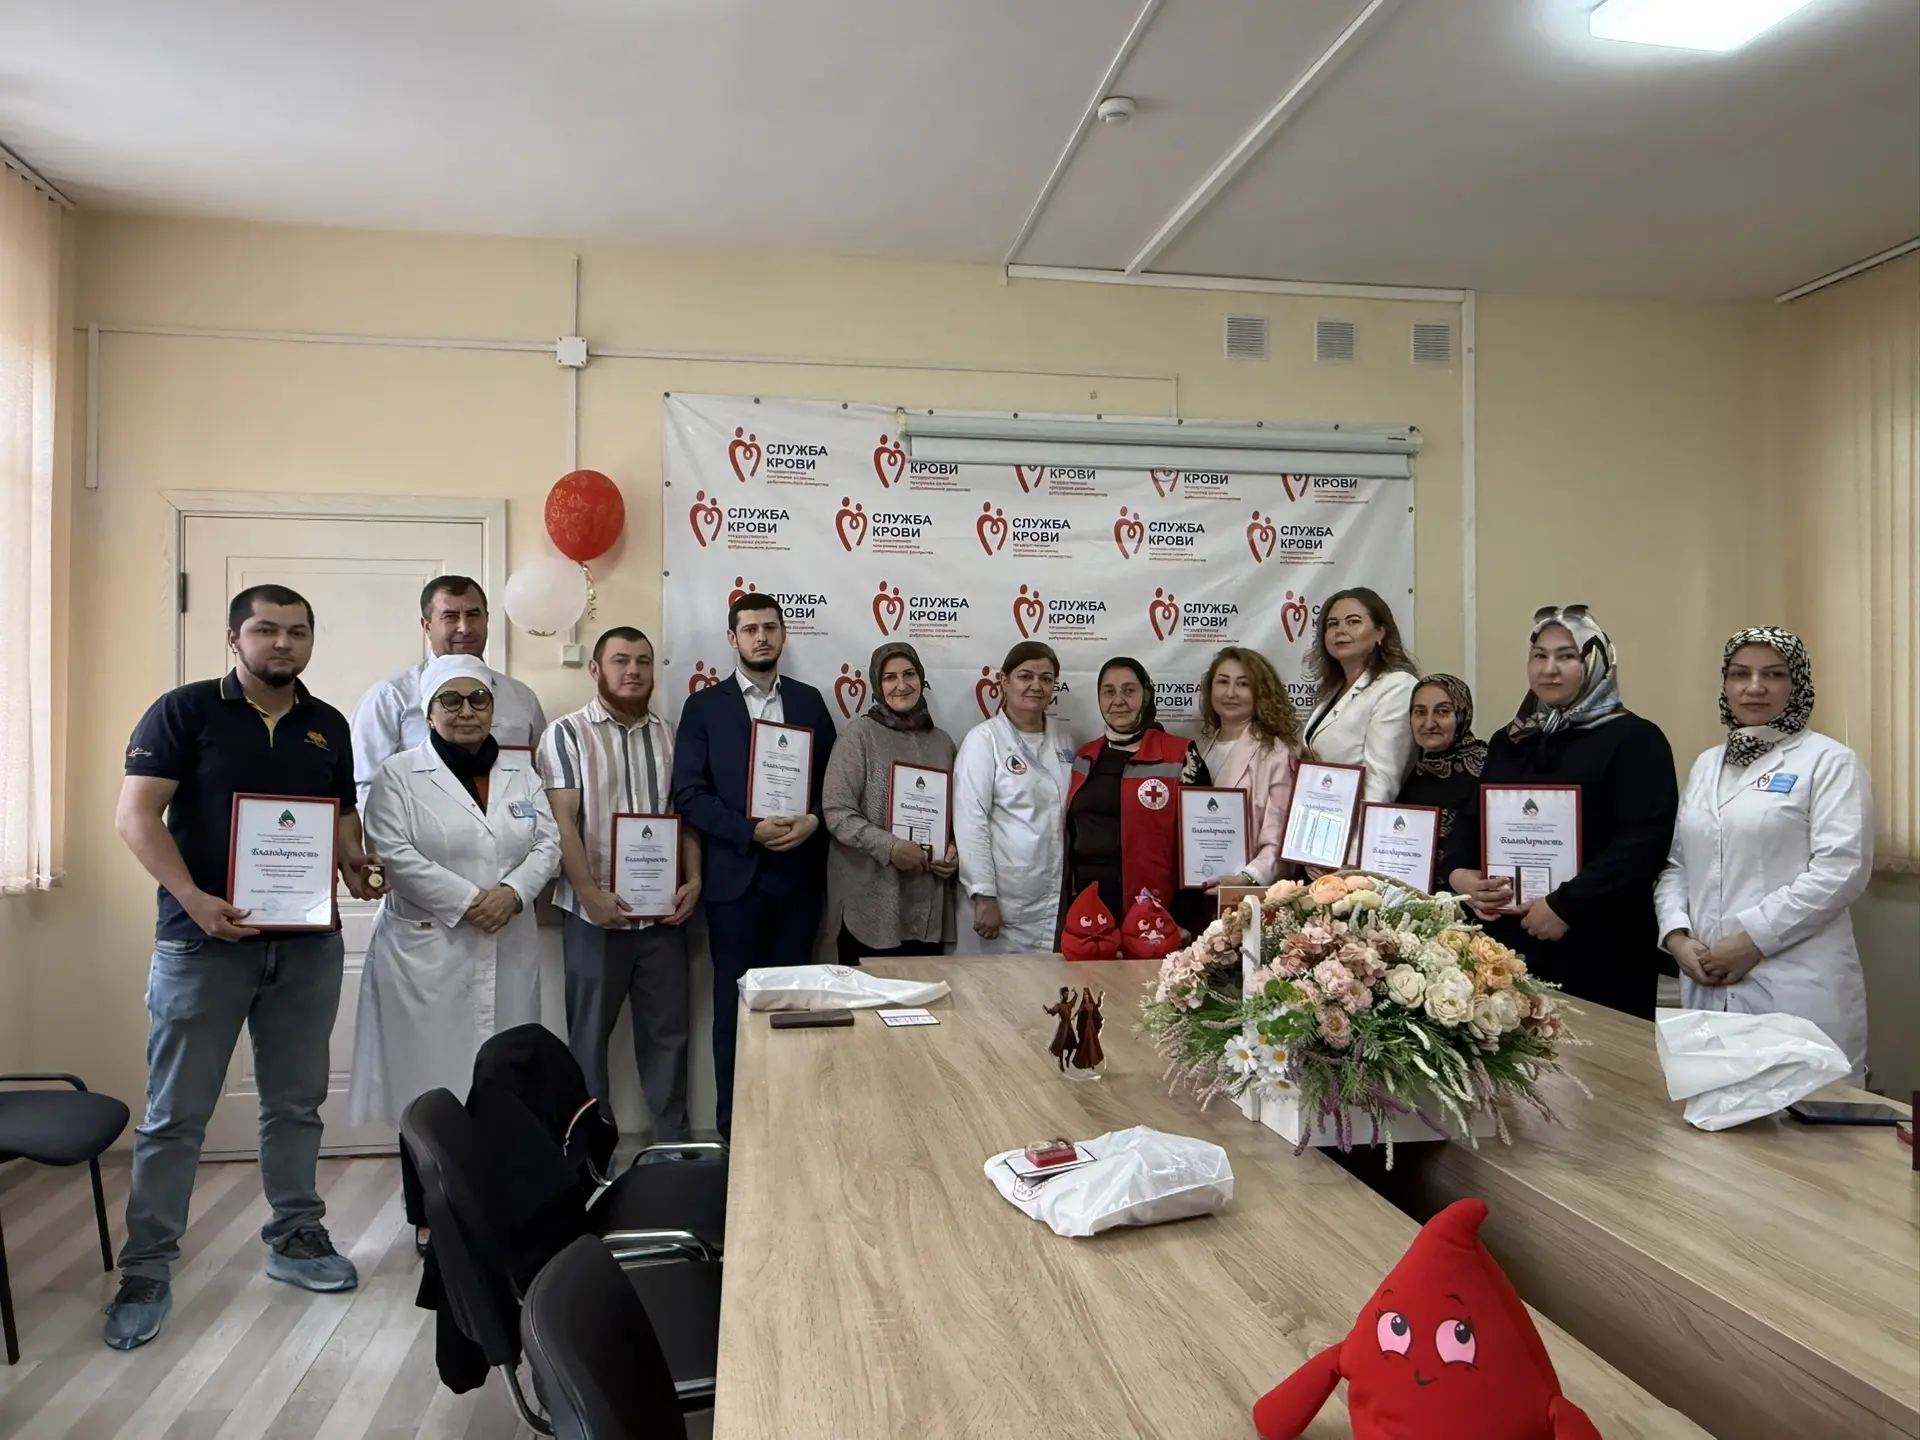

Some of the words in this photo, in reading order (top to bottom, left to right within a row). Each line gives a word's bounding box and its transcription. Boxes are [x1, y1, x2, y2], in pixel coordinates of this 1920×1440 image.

[766, 444, 828, 456] СЛУЖБА
[767, 458, 815, 470] КРОВИ
[910, 463, 958, 474] КРОВИ
[1050, 468, 1096, 480] КРОВИ
[1184, 474, 1229, 484] КРОВИ
[1313, 478, 1358, 488] КРОВИ
[728, 508, 790, 520] СЛУЖБА
[872, 513, 932, 525] СЛУЖБА
[728, 522, 777, 533] КРОВИ
[1012, 518, 1071, 529] СЛУЖБА
[1149, 522, 1205, 533] СЛУЖБА
[872, 526, 920, 537] КРОВИ
[1012, 531, 1059, 542] КРОВИ
[1280, 526, 1334, 537] СЛУЖБА
[1149, 535, 1193, 546] КРОВИ
[1280, 539, 1323, 549] КРОВИ
[768, 593, 828, 605] ЛУЖБА
[910, 597, 969, 608] СЛУЖБА
[1049, 600, 1106, 611] СЛУЖБА
[1184, 603, 1238, 614] СЛУЖБА
[784, 607, 815, 618] ОВИ
[909, 611, 957, 621] КРОВИ
[1049, 613, 1094, 624] КРОВИ
[1183, 616, 1227, 627] КРОВИ
[1153, 683, 1201, 694] ЛУЖБА
[1155, 697, 1193, 707] РОВИ
